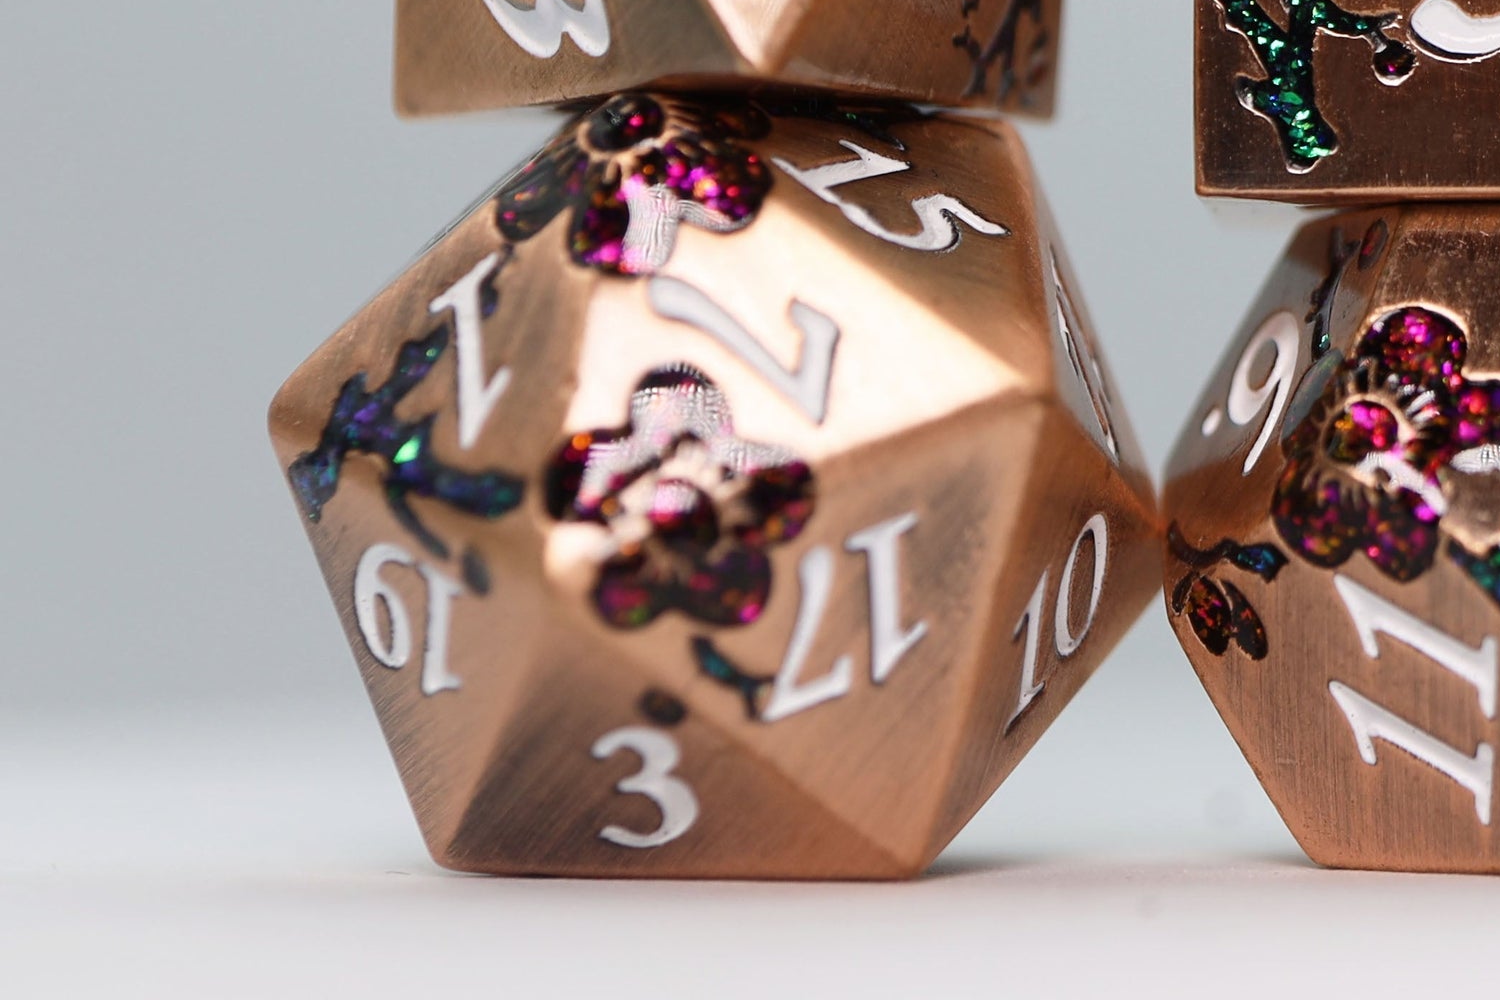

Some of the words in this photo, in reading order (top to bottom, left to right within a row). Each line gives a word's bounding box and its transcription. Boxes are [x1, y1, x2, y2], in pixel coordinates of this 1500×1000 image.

[760, 512, 931, 723] 17
[1003, 514, 1108, 737] 10
[1329, 574, 1497, 826] 11
[591, 726, 701, 850] 3
